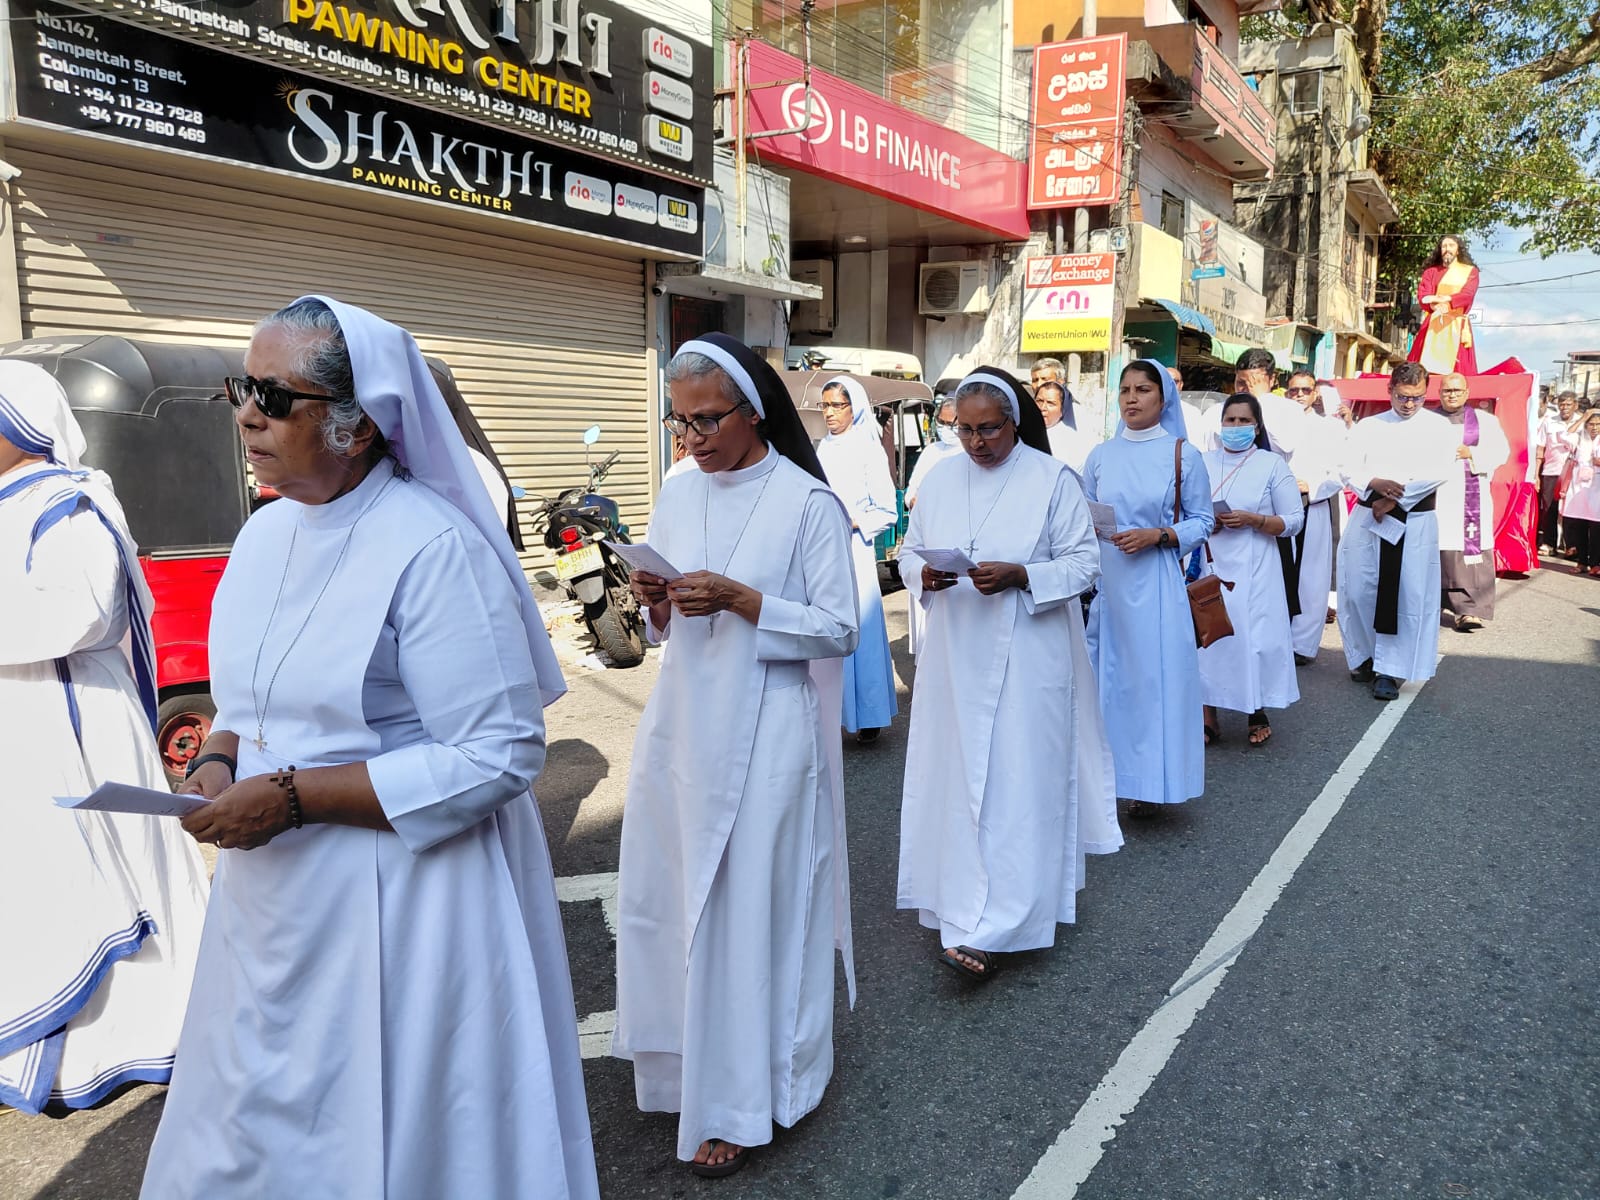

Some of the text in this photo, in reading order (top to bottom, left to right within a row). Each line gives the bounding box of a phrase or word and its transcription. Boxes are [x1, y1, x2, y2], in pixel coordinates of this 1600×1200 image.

[37, 31, 187, 86] Jampettah Street,
[288, 0, 592, 118] PAWNING CENTER
[653, 35, 672, 60] ria
[39, 52, 117, 87] Colombo
[132, 77, 150, 94] 13
[150, 0, 251, 38] Jampettah
[257, 26, 316, 59] Street,
[318, 45, 383, 77] Colombo
[395, 67, 410, 86] 13
[479, 93, 490, 110] 11
[492, 97, 516, 117] 232
[518, 105, 546, 126] 7928
[557, 119, 577, 135] +94
[579, 125, 597, 141] 777
[599, 131, 618, 147] 960
[619, 138, 638, 153] 469
[1047, 62, 1109, 102] උකස්
[40, 73, 71, 96] Tel
[83, 86, 114, 105] +94
[119, 94, 132, 109] 11
[135, 98, 164, 117] 232
[167, 104, 203, 125] 7928
[80, 104, 206, 144] +94 777 960 469
[288, 88, 554, 201] SHAKTHI
[840, 108, 961, 190] LB FINANCE
[352, 166, 513, 212] PAWNING CENTER
[570, 179, 590, 201] ria
[1052, 267, 1110, 282] exchange
[1061, 255, 1103, 268] money
